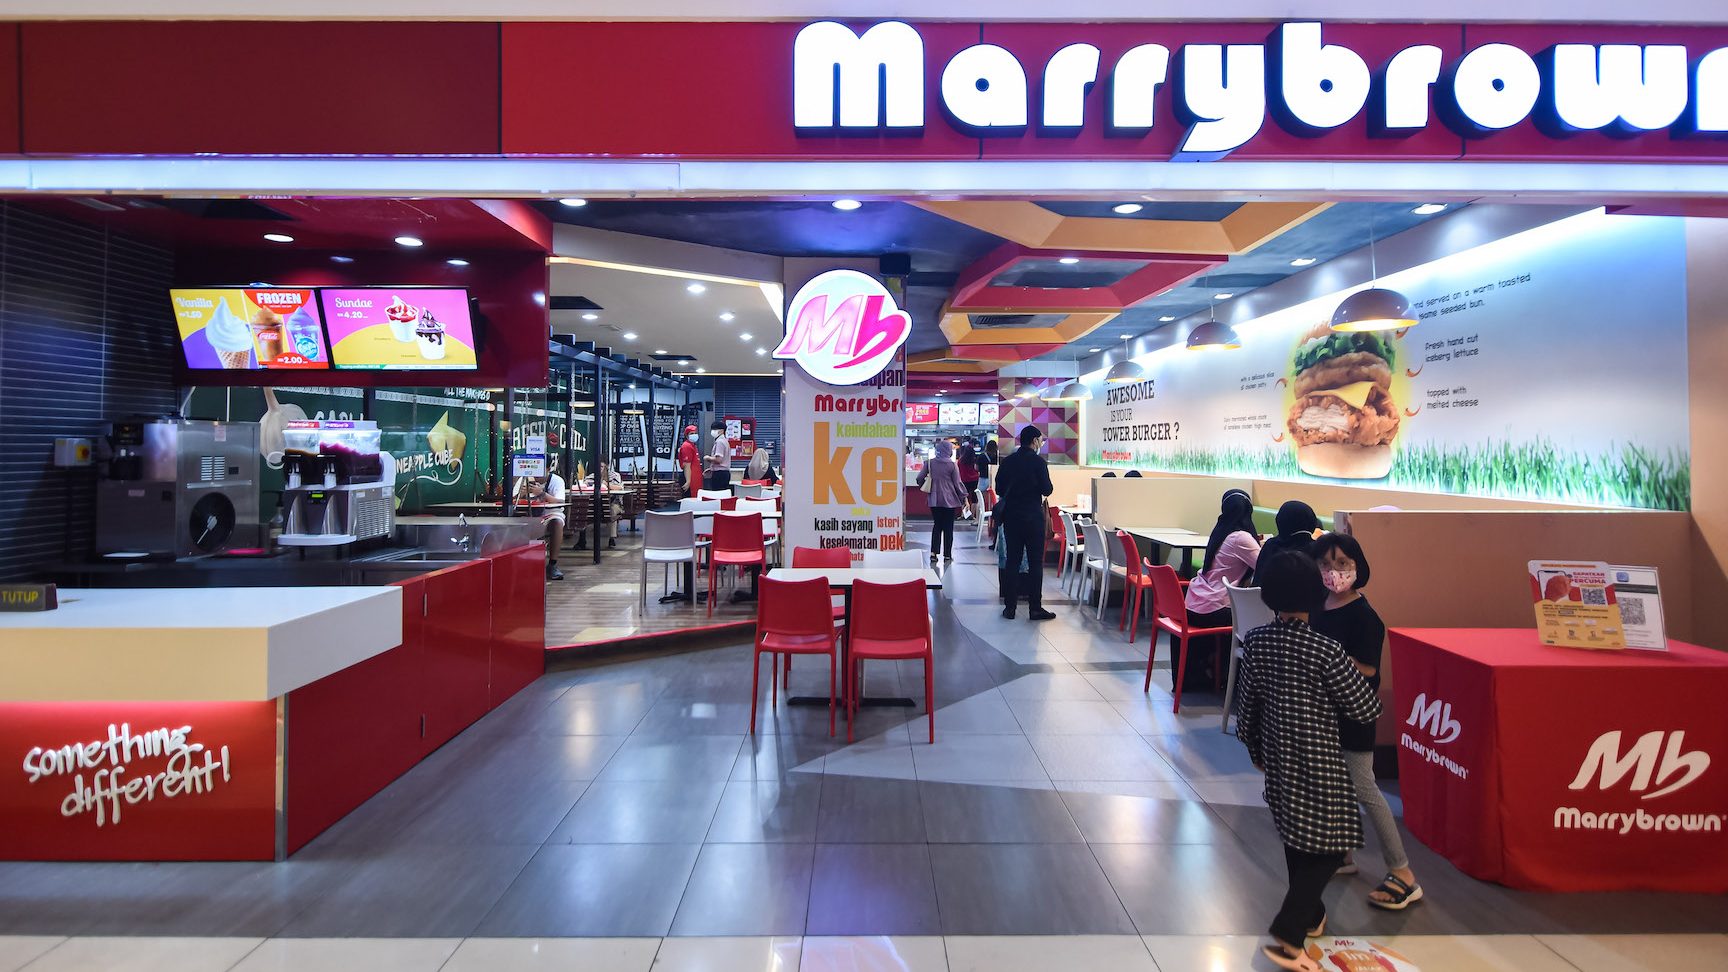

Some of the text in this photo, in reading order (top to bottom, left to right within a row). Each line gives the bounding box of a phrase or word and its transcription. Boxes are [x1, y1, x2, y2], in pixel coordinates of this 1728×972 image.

[256, 292, 302, 304] FROZEN
[1426, 293, 1450, 307] served
[1465, 289, 1470, 297] a
[1473, 282, 1494, 295] warm
[1498, 272, 1531, 288] toasted
[176, 297, 213, 308] Vanilla
[335, 298, 373, 308] Sundae
[1441, 303, 1466, 315] seeded
[777, 294, 907, 369] Mb
[1447, 337, 1464, 347] hand
[1467, 334, 1478, 344] cut
[1425, 347, 1479, 362] iceberg lettuce
[1106, 380, 1154, 406] AWESOME
[1427, 386, 1466, 398] topped with
[1427, 398, 1479, 409] melted cheese
[1110, 408, 1132, 422] IS YOUR
[836, 421, 897, 438] keindahan
[1103, 426, 1130, 441] TOWER
[1132, 423, 1171, 441] BURGER
[813, 421, 898, 506] ke
[814, 516, 900, 533] kasih sayang isteri
[820, 535, 877, 549] keselamatan
[1, 591, 39, 602] TUTUP
[1405, 692, 1461, 744] Mb
[23, 722, 203, 784] something
[1401, 732, 1468, 780] Marrybrown
[1568, 730, 1711, 800] Mb
[1554, 806, 1722, 835] Marrybrown
